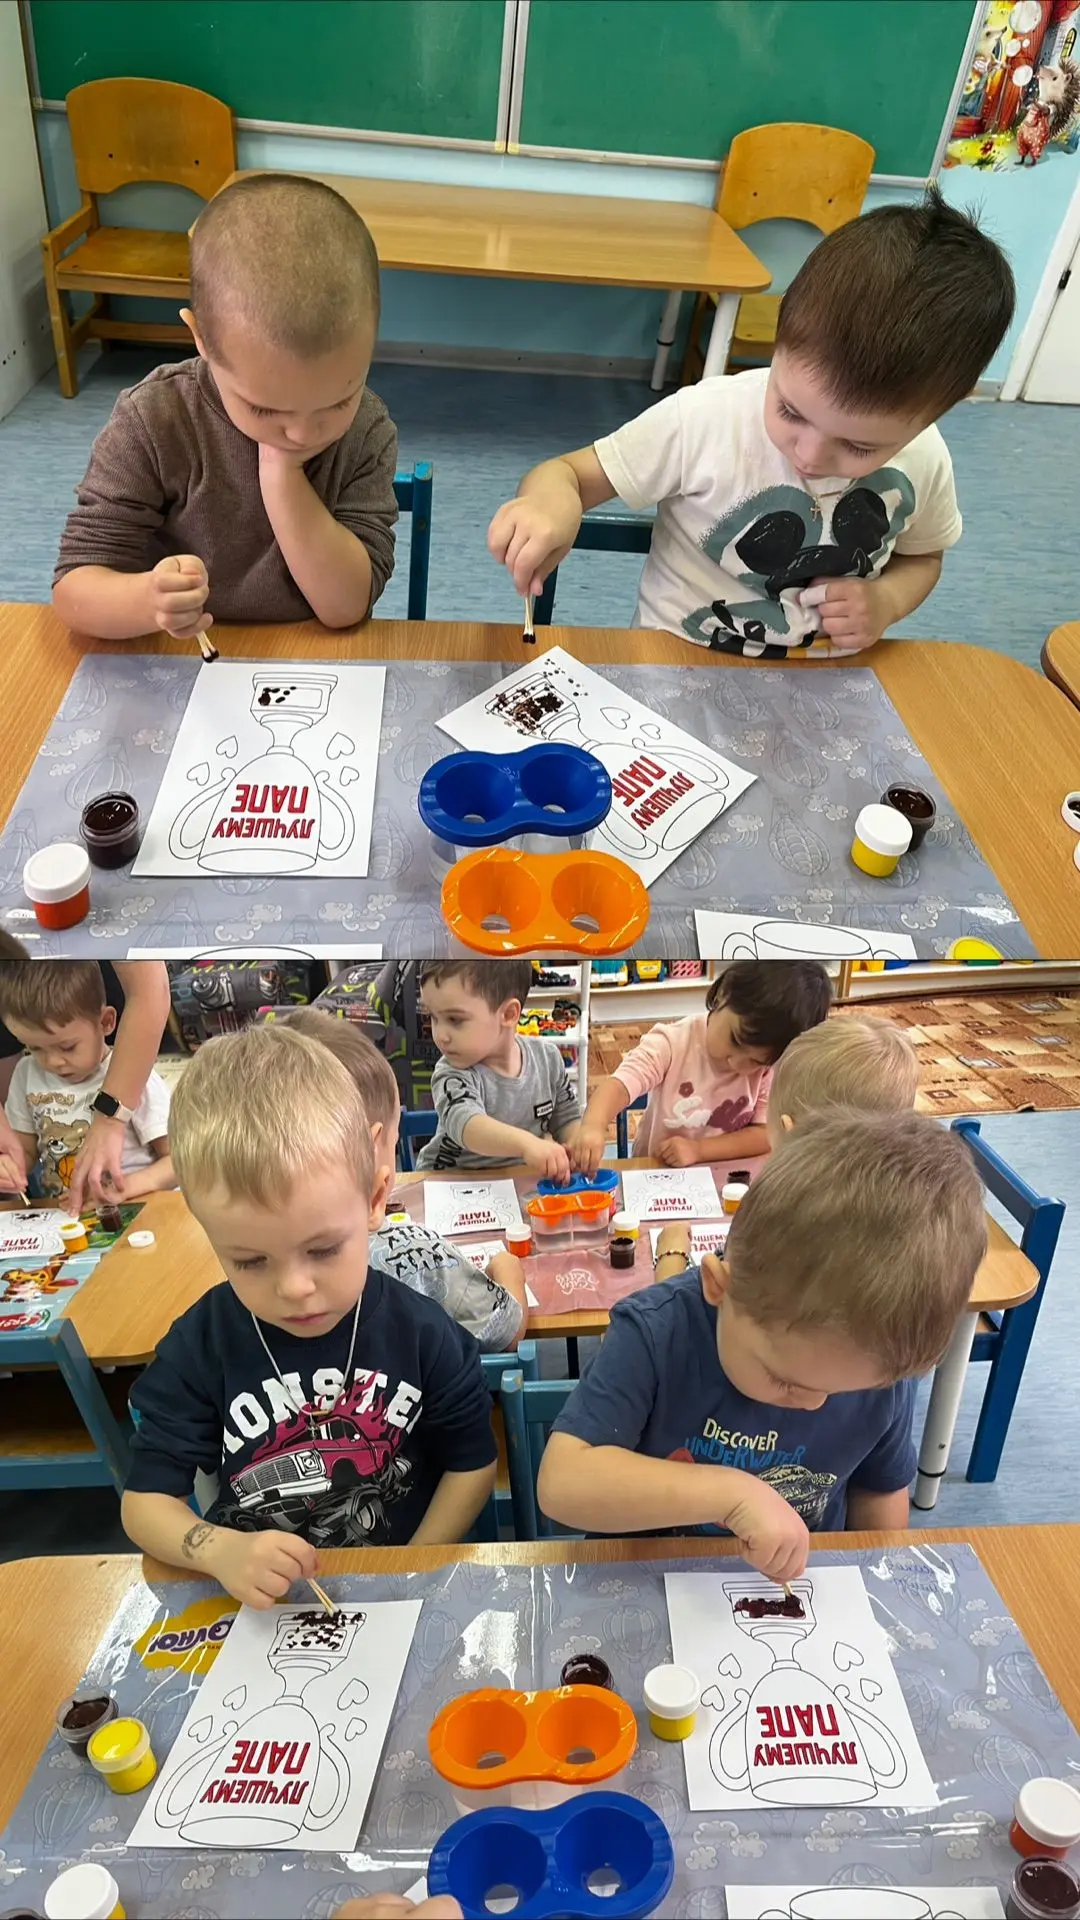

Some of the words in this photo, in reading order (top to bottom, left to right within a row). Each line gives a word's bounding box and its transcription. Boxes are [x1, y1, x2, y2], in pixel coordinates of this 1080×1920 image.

[231, 784, 309, 815] ПАПЕ
[630, 771, 695, 831] ЛУЧШЕМУ
[211, 817, 316, 839] ЛУЧШЕМУ
[648, 1205, 692, 1213] ЛУЧШЕМУ
[652, 1198, 686, 1207] ПАПЕ
[454, 1217, 497, 1228] ЛУЧШЕМУ
[458, 1211, 491, 1221] ПАПЕ
[3, 1237, 38, 1247] ПАПЕ
[222, 1367, 423, 1464] ONSTE
[756, 1704, 840, 1738] ПАПЕ
[224, 1740, 311, 1775] ПАПЕ
[753, 1741, 858, 1767] ЛУЧШЕМУ
[199, 1779, 310, 1805] ЛУЧШЕМУ
